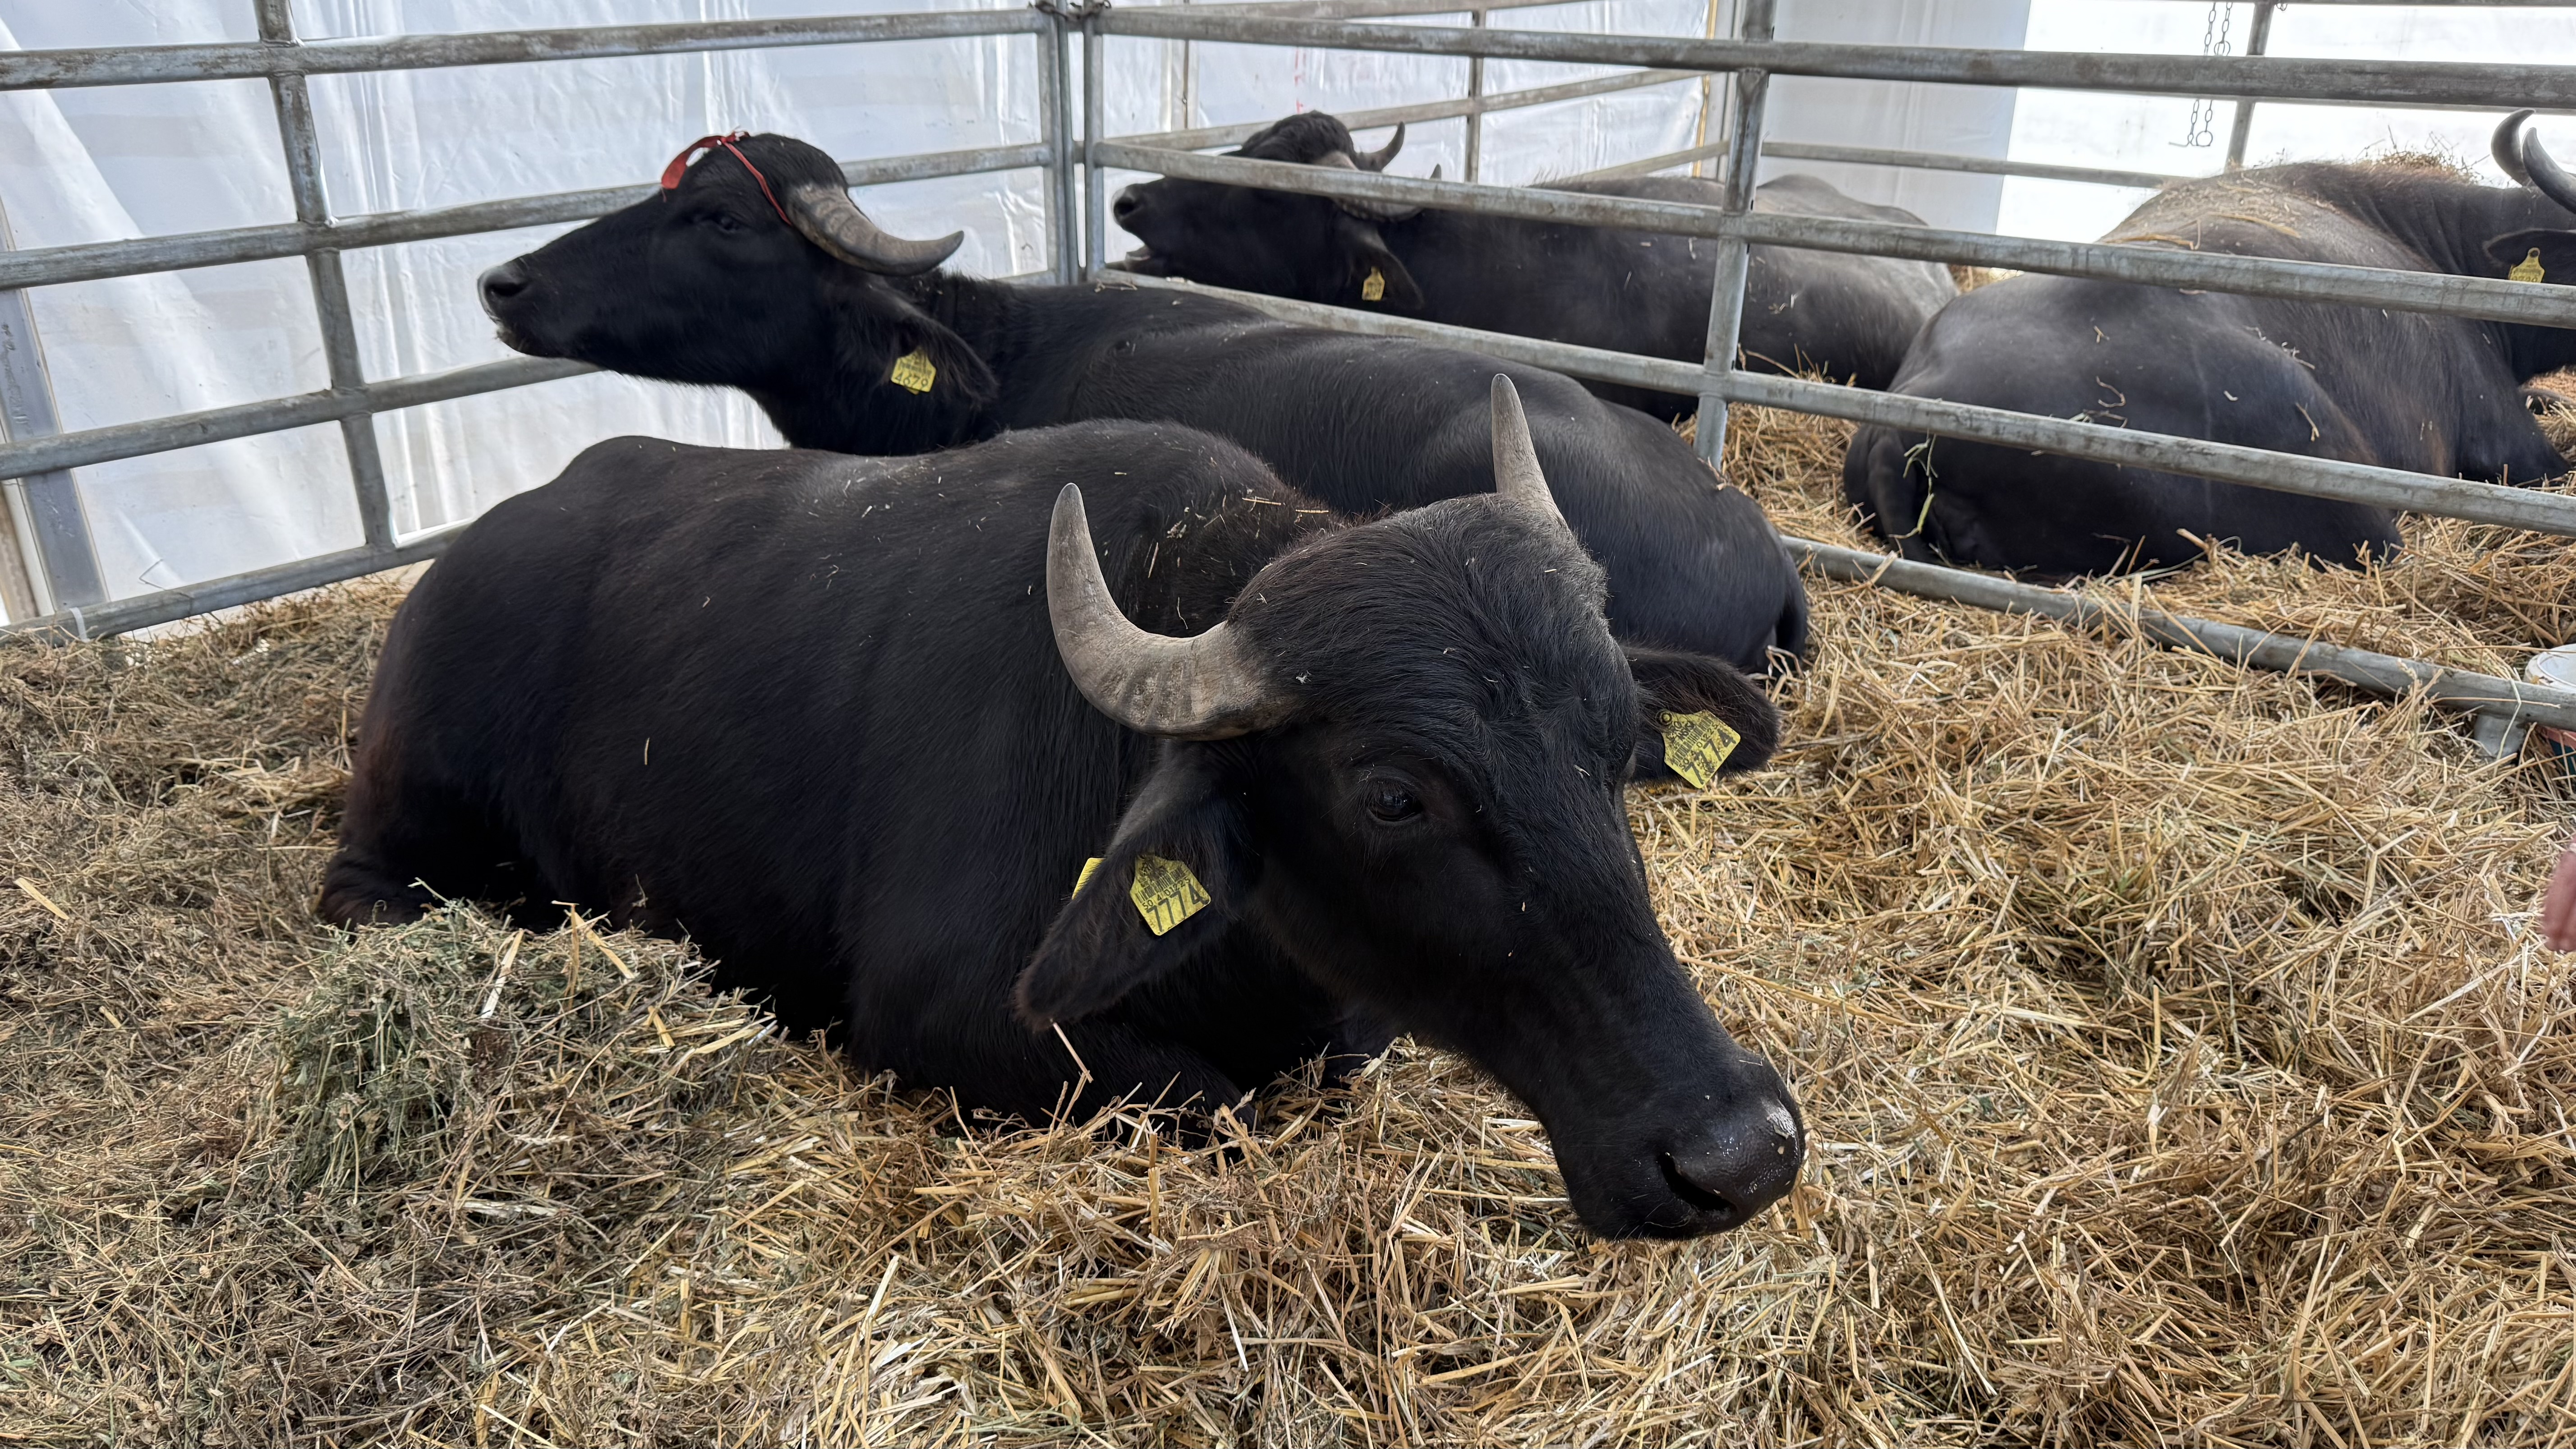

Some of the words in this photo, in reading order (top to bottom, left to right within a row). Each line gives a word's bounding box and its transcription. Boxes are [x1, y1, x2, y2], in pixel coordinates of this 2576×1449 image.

[1684, 728, 1736, 785] 7774
[1142, 897, 1154, 910] 50
[1146, 883, 1210, 933] 7774
